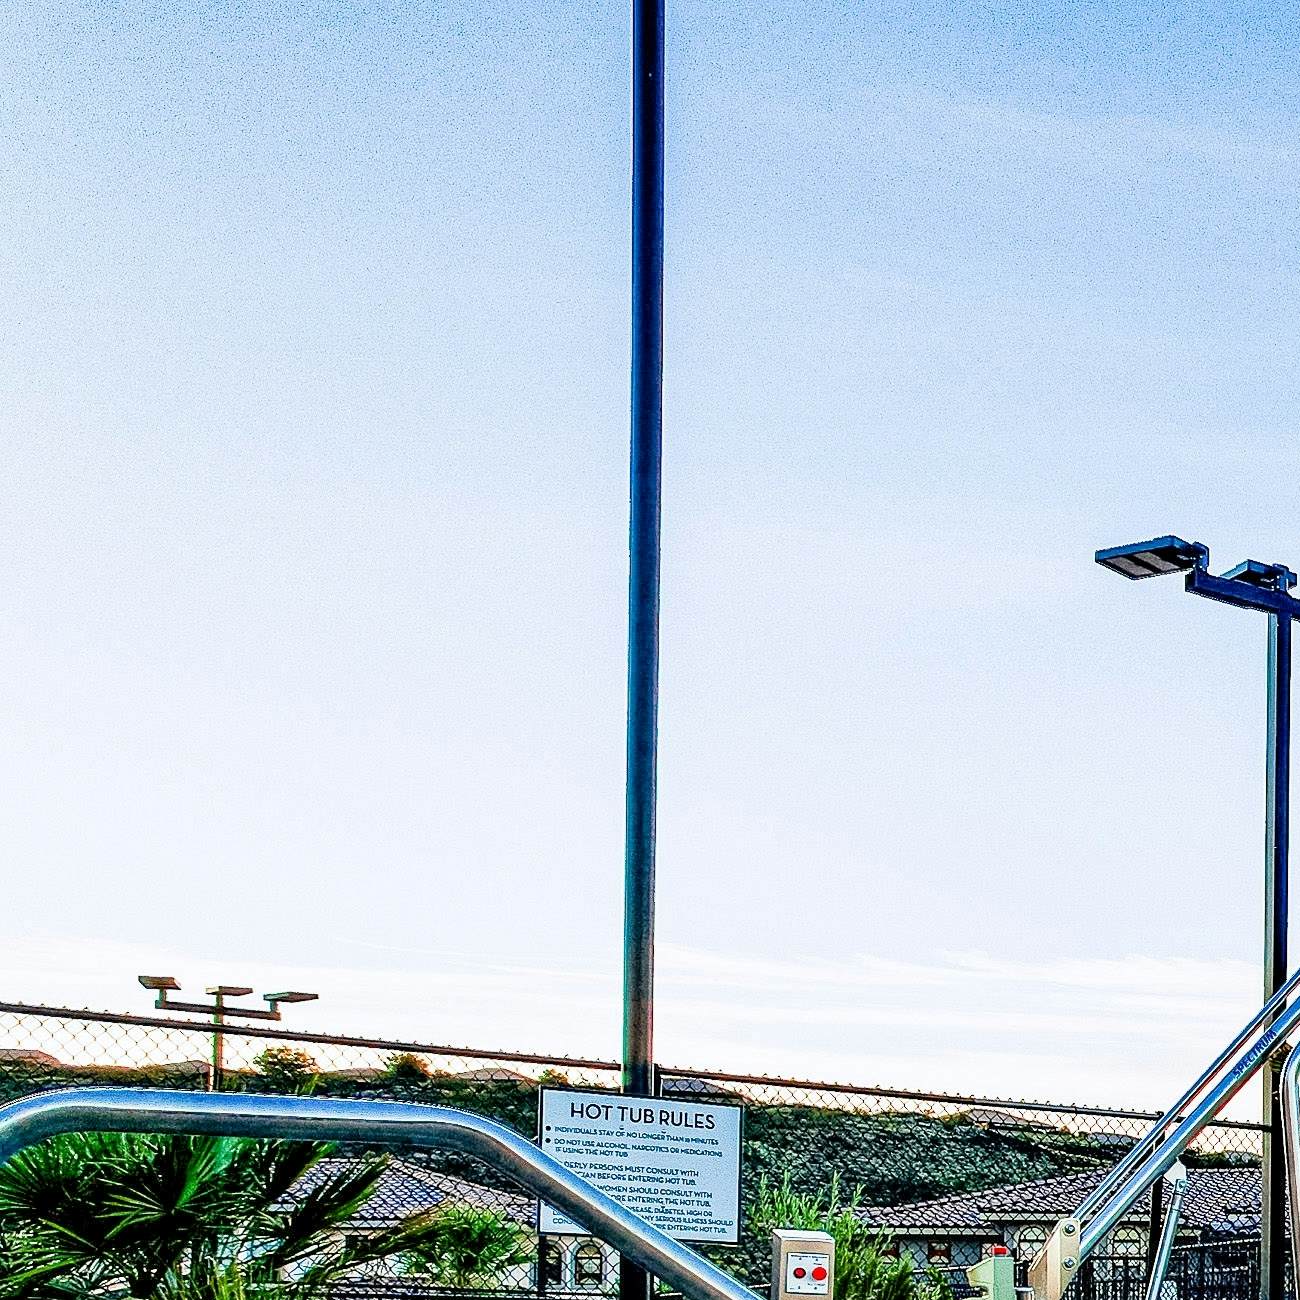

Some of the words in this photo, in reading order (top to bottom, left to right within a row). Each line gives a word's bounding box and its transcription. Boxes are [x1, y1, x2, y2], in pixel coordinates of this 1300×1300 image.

[1232, 1028, 1277, 1080] SPECTRUM
[570, 1102, 613, 1120] HOT
[617, 1106, 654, 1123] TUB
[659, 1110, 716, 1130] RULES
[554, 1126, 597, 1135] INDIVIDUALS
[638, 1133, 665, 1141] LONGER
[691, 1137, 719, 1146] MINUTES
[562, 1147, 584, 1155] USING
[584, 1148, 599, 1156] THE
[600, 1149, 614, 1157] HOT
[631, 1144, 669, 1153] NARCOTICS
[680, 1148, 723, 1158] MEDICATIONS
[589, 1162, 624, 1171] PERSONS
[624, 1165, 645, 1173] MUST
[645, 1166, 679, 1176] CONSULT
[680, 1169, 699, 1178] WITH
[597, 1172, 627, 1181] BEFORE
[627, 1174, 664, 1184] ENTERING
[664, 1177, 681, 1185] HOT
[628, 1186, 659, 1195] SHOULD
[659, 1188, 693, 1198] CONSULT
[693, 1191, 713, 1199] WITH
[627, 1195, 664, 1205] ENTERING
[664, 1197, 679, 1205] THE
[679, 1199, 696, 1207] HOT
[686, 1209, 703, 1217] HIGH
[702, 1210, 713, 1218] OR
[655, 1215, 681, 1224] SERIOUS
[682, 1217, 708, 1226] ILLNESS
[707, 1219, 734, 1227] SHOULD
[667, 1224, 699, 1233] ENTERING
